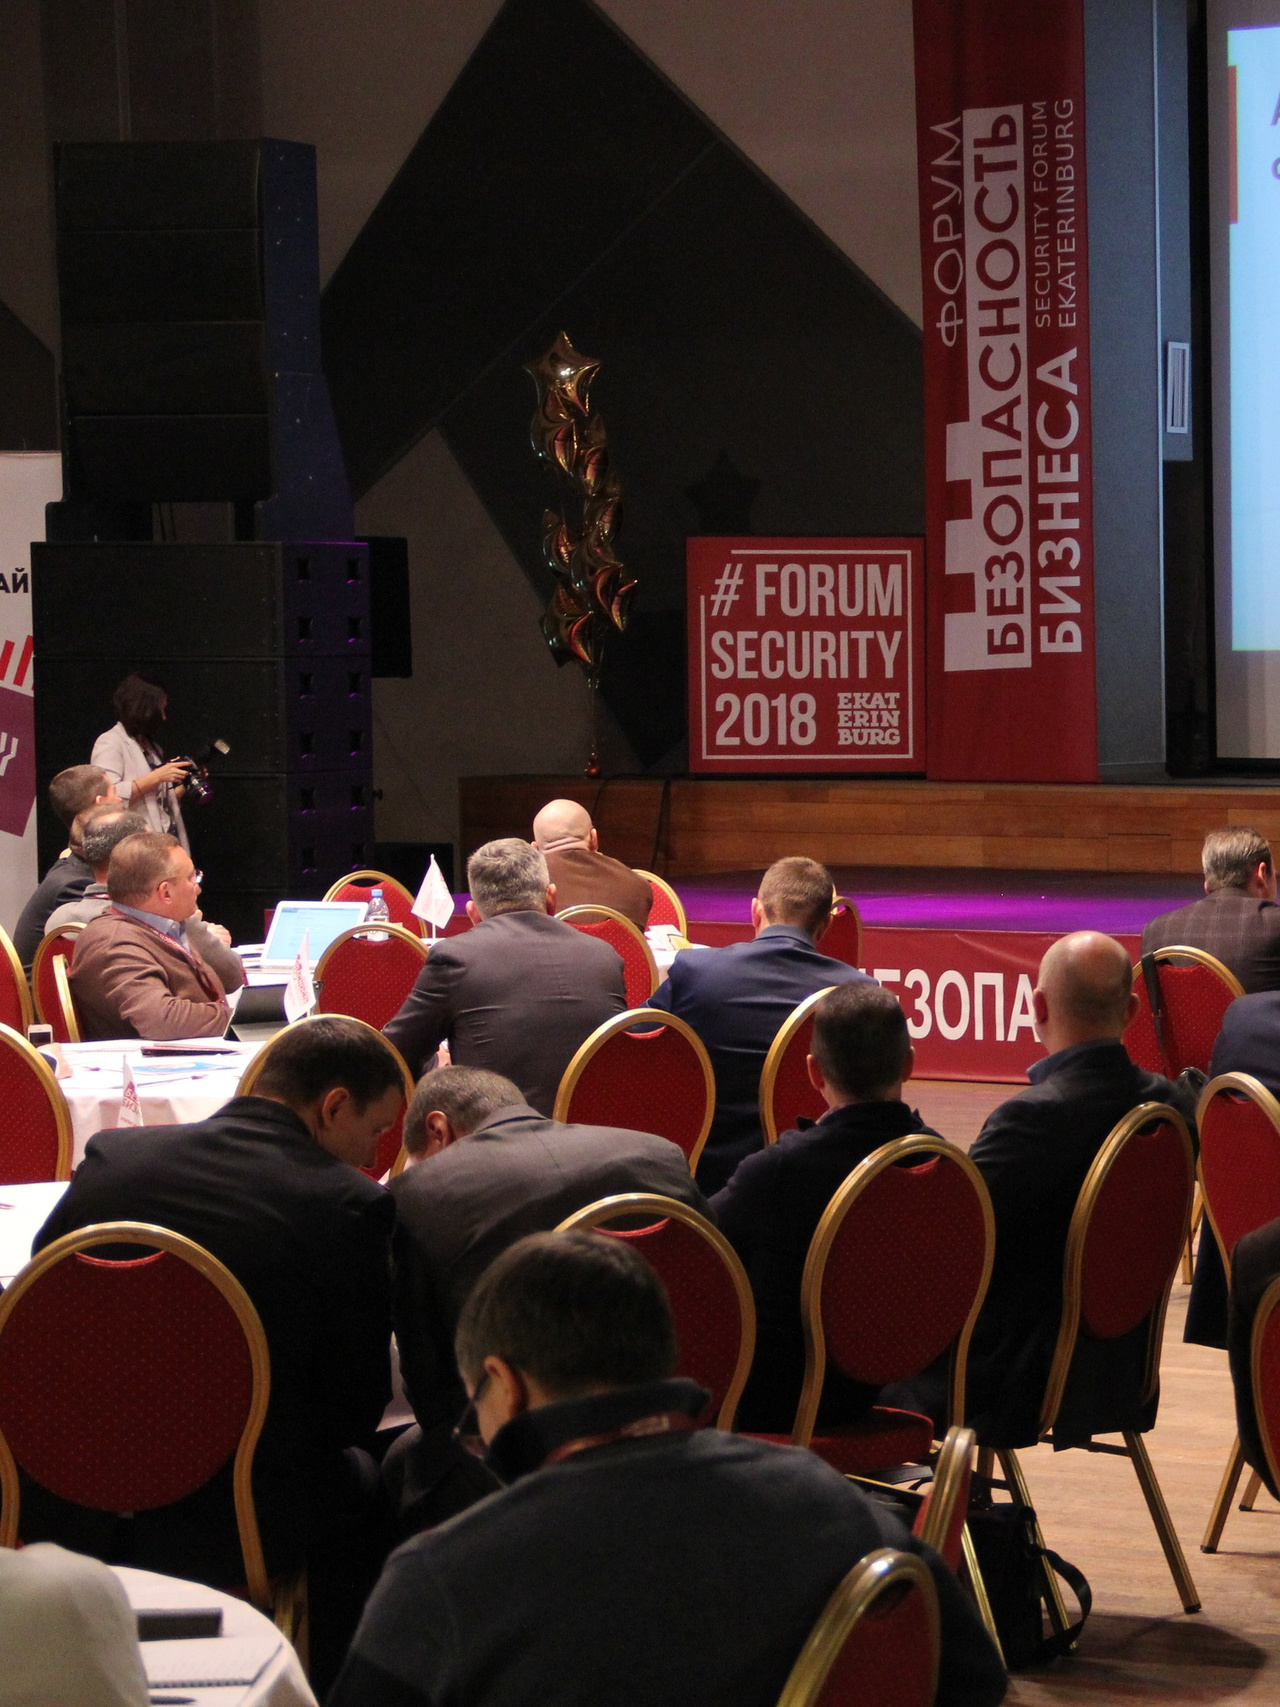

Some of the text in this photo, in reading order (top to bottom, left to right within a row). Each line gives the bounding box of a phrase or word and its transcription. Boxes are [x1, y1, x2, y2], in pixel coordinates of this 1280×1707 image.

[929, 116, 964, 347] ФОРУМ
[1032, 101, 1051, 328] SECURITY FORUM
[1054, 98, 1077, 328] EKATERINBURG
[973, 113, 1025, 656] БЕЗОПАСНОСТЬ
[1036, 346, 1083, 654] БИЗНЕСА
[711, 630, 902, 679] SECURITY
[755, 563, 902, 617] FORUM
[715, 692, 900, 746] 2018 EKAT
[837, 710, 900, 727] ERIN
[837, 728, 901, 745] BURG
